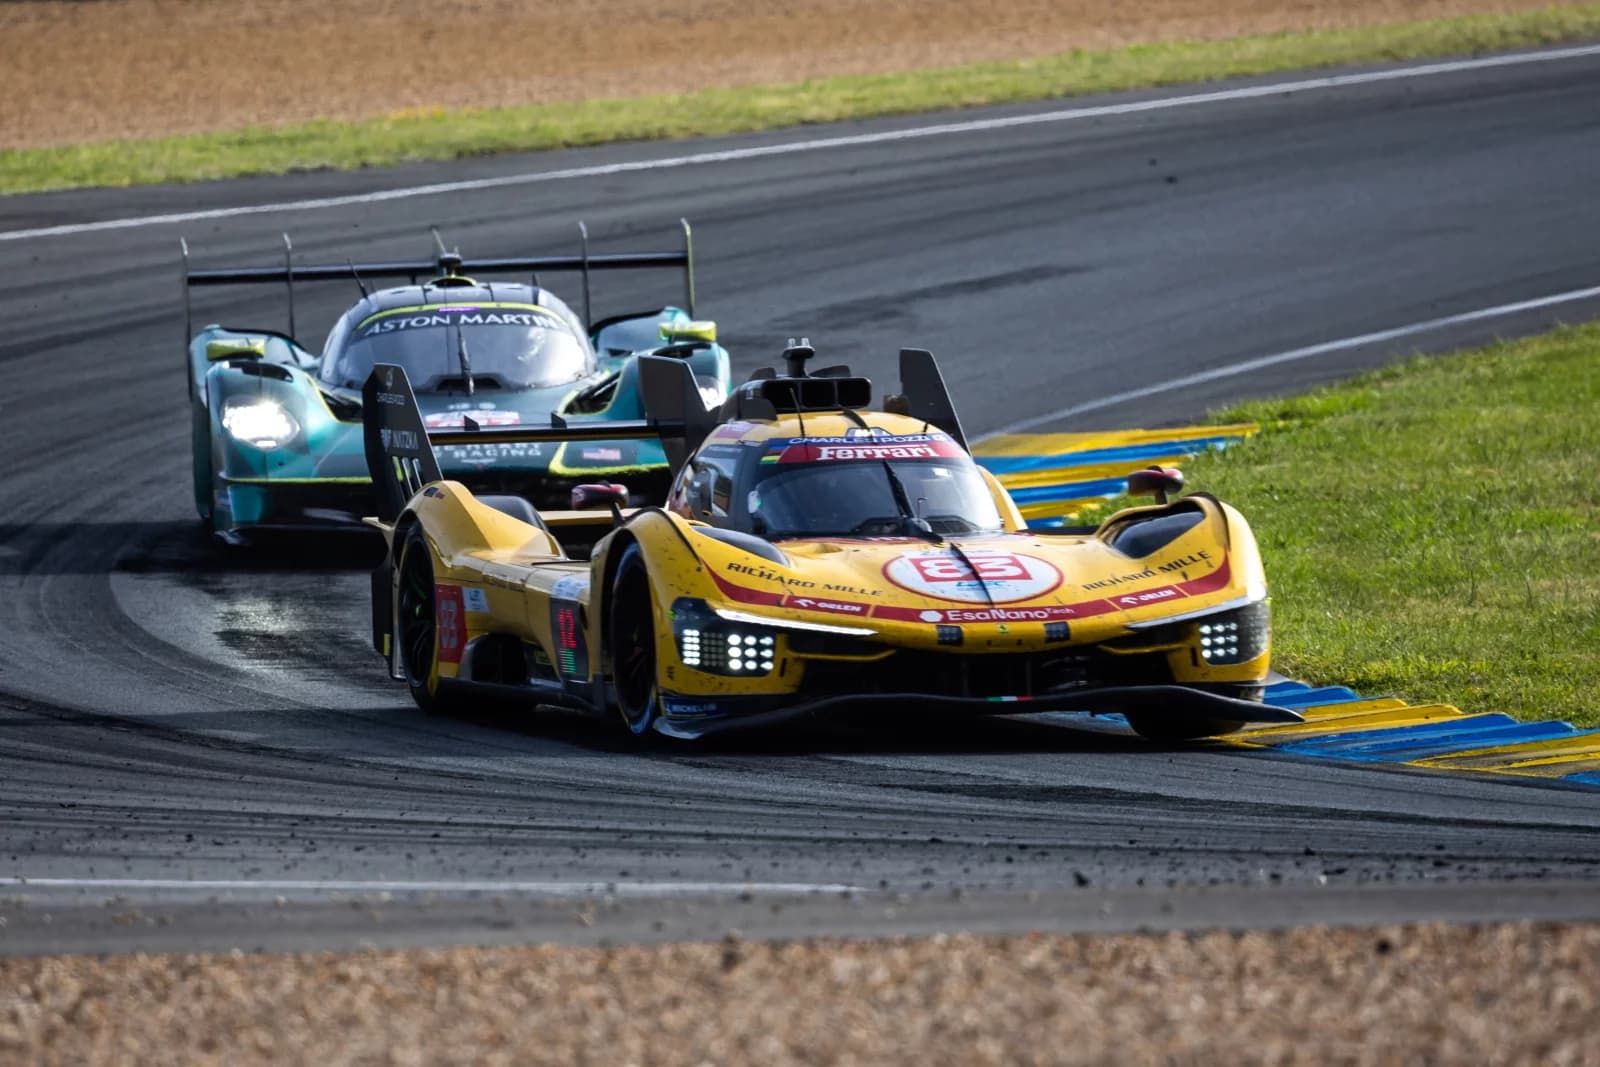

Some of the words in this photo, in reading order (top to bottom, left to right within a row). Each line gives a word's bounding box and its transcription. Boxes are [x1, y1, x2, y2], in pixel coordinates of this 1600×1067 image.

[365, 315, 450, 336] ASTON
[459, 314, 559, 328] MARTIN
[453, 449, 541, 458] RACING
[815, 443, 941, 461] Ferrari
[918, 556, 1023, 578] 83
[1082, 569, 1155, 591] RICHARD
[1158, 551, 1212, 573] MILLE
[727, 562, 815, 588] RICHARD
[823, 583, 882, 597] MILLE
[1138, 589, 1176, 601] ORLEN
[816, 602, 862, 612] ORLEN
